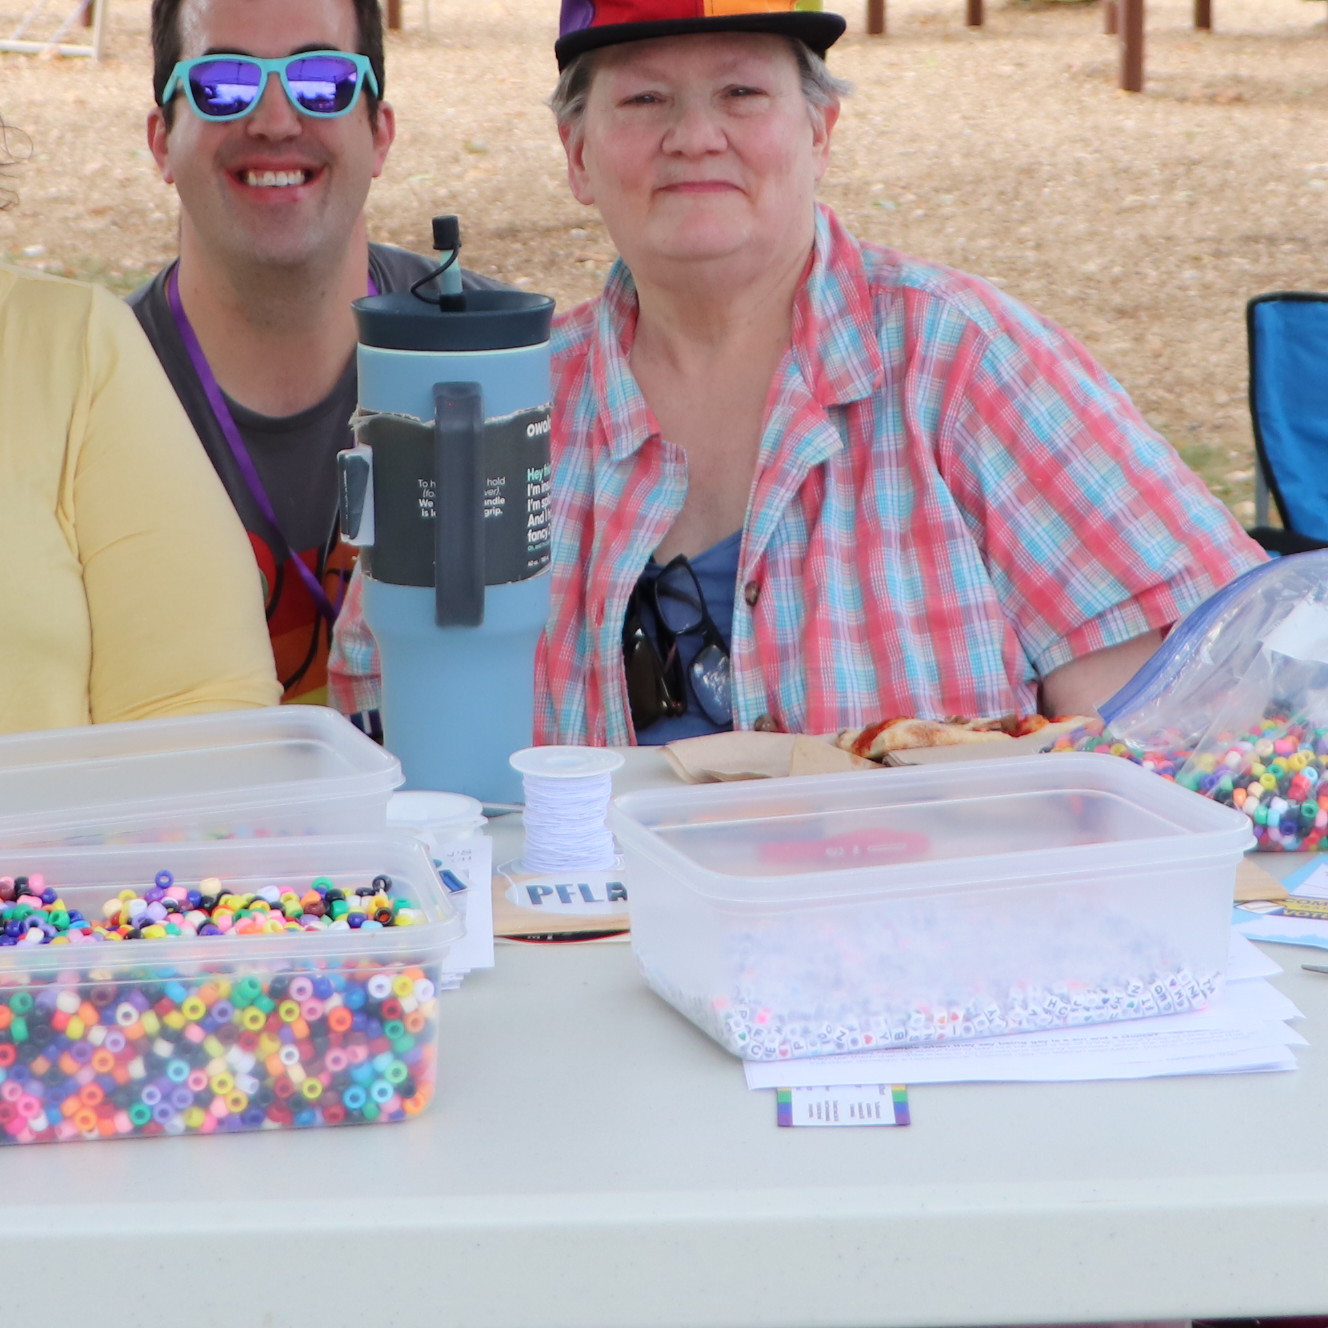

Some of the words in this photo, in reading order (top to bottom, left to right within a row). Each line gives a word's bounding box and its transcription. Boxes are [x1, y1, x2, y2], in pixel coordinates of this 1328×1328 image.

[527, 416, 551, 438] owal
[418, 479, 428, 488] To
[486, 476, 506, 486] hold
[527, 466, 543, 482] Hey
[484, 486, 502, 496] ver).
[527, 482, 540, 497] I'm
[418, 498, 434, 508] We
[527, 497, 540, 513] I'm
[421, 509, 428, 517] is
[484, 507, 503, 518] grip.
[527, 510, 544, 528] And
[527, 526, 548, 543] fancy
[526, 881, 629, 905] PFLA
